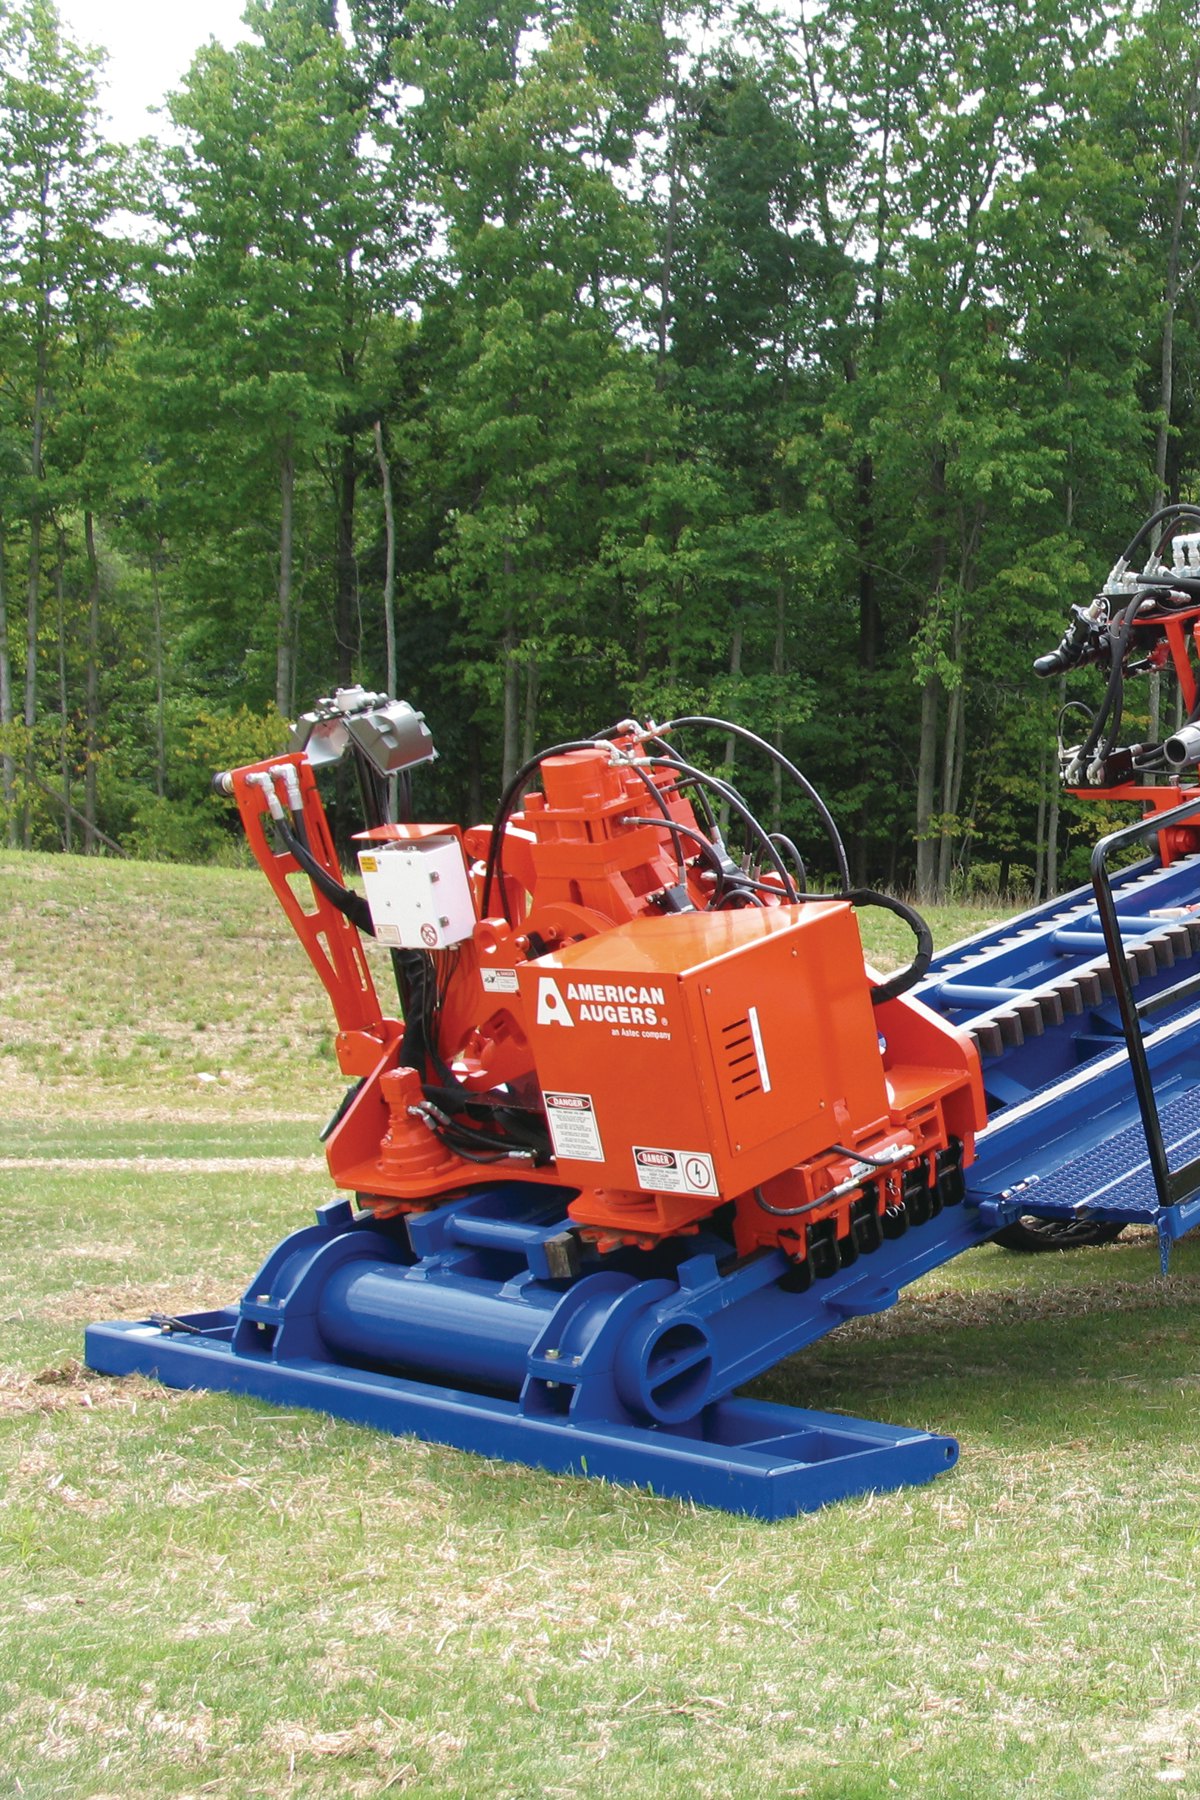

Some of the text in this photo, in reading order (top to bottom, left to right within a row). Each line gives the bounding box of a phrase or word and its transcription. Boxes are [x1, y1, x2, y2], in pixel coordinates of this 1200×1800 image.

[567, 983, 665, 1005] AMERICAN
[580, 1004, 658, 1026] AUGERS
[611, 1028, 671, 1041] an Astec company
[553, 1097, 583, 1107] DANGER
[642, 1153, 669, 1164] DANGER
